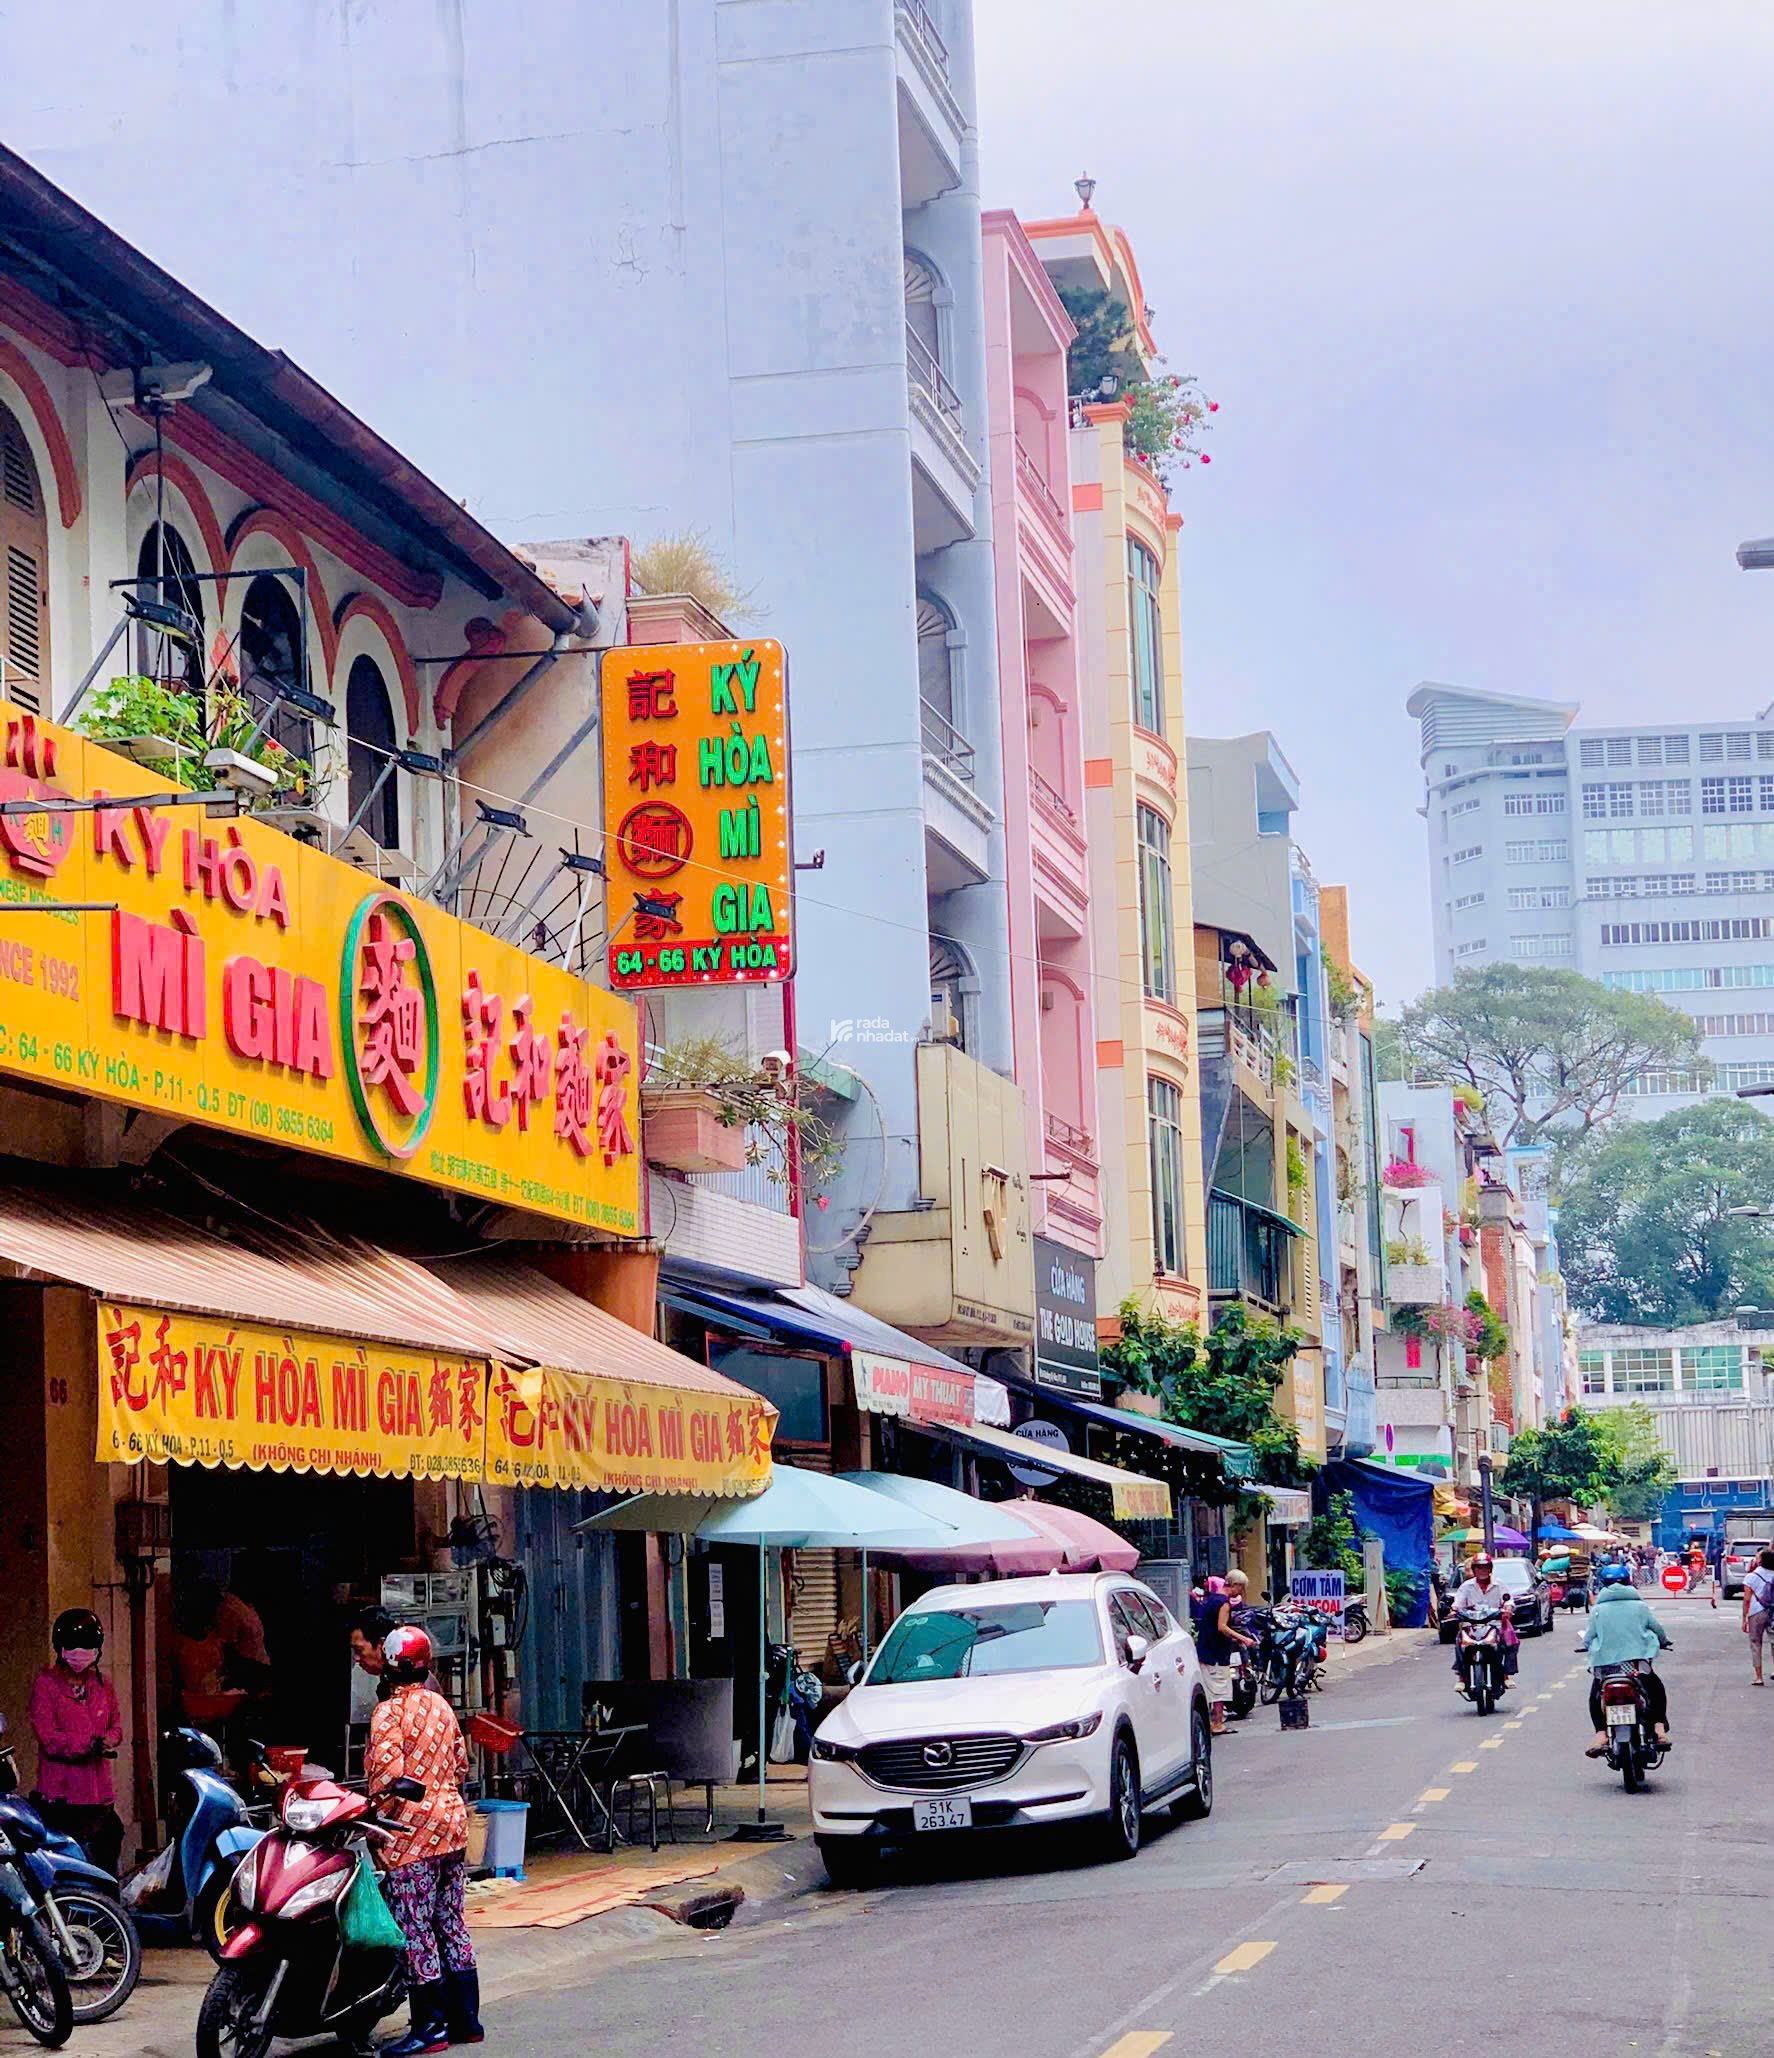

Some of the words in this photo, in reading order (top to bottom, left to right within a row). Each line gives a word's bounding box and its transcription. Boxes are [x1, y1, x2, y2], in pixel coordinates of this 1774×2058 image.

[710, 649, 760, 714] KÝ
[699, 722, 773, 787] HÒA
[718, 794, 761, 858] MÌ
[183, 826, 290, 928] HÒA
[712, 882, 774, 934] GIA
[41, 953, 80, 1003] 1992
[617, 951, 643, 974] 64
[659, 948, 685, 973] 66
[692, 938, 721, 972] KÝ
[730, 936, 777, 969] HÒA
[112, 908, 206, 1040] MÌ
[223, 956, 334, 1080] GIA
[19, 1032, 38, 1062] 64
[54, 1042, 72, 1072] 66
[106, 1051, 140, 1091] HÒA
[154, 1070, 183, 1103] P.11
[1039, 1307, 1053, 1342] THE
[1054, 1313, 1073, 1346] GOLD
[1074, 1319, 1095, 1352] HOUSE
[106, 1308, 188, 1415] 記和
[194, 1327, 244, 1420] KÝ
[255, 1335, 322, 1428] HÒA
[332, 1347, 369, 1433] MÌ
[377, 1367, 426, 1438] GIA
[563, 1383, 598, 1452] KÝ
[604, 1385, 652, 1459] HÒA
[658, 1396, 685, 1460] MÌ
[690, 1409, 724, 1464] GIA
[253, 1442, 305, 1463] (KHÔNG
[335, 1447, 382, 1469] NHÁNH)
[494, 1459, 509, 1475] 64
[1292, 1575, 1317, 1597] CƠM
[920, 1813, 965, 1829] 263.47
[929, 1801, 954, 1815] 51K
